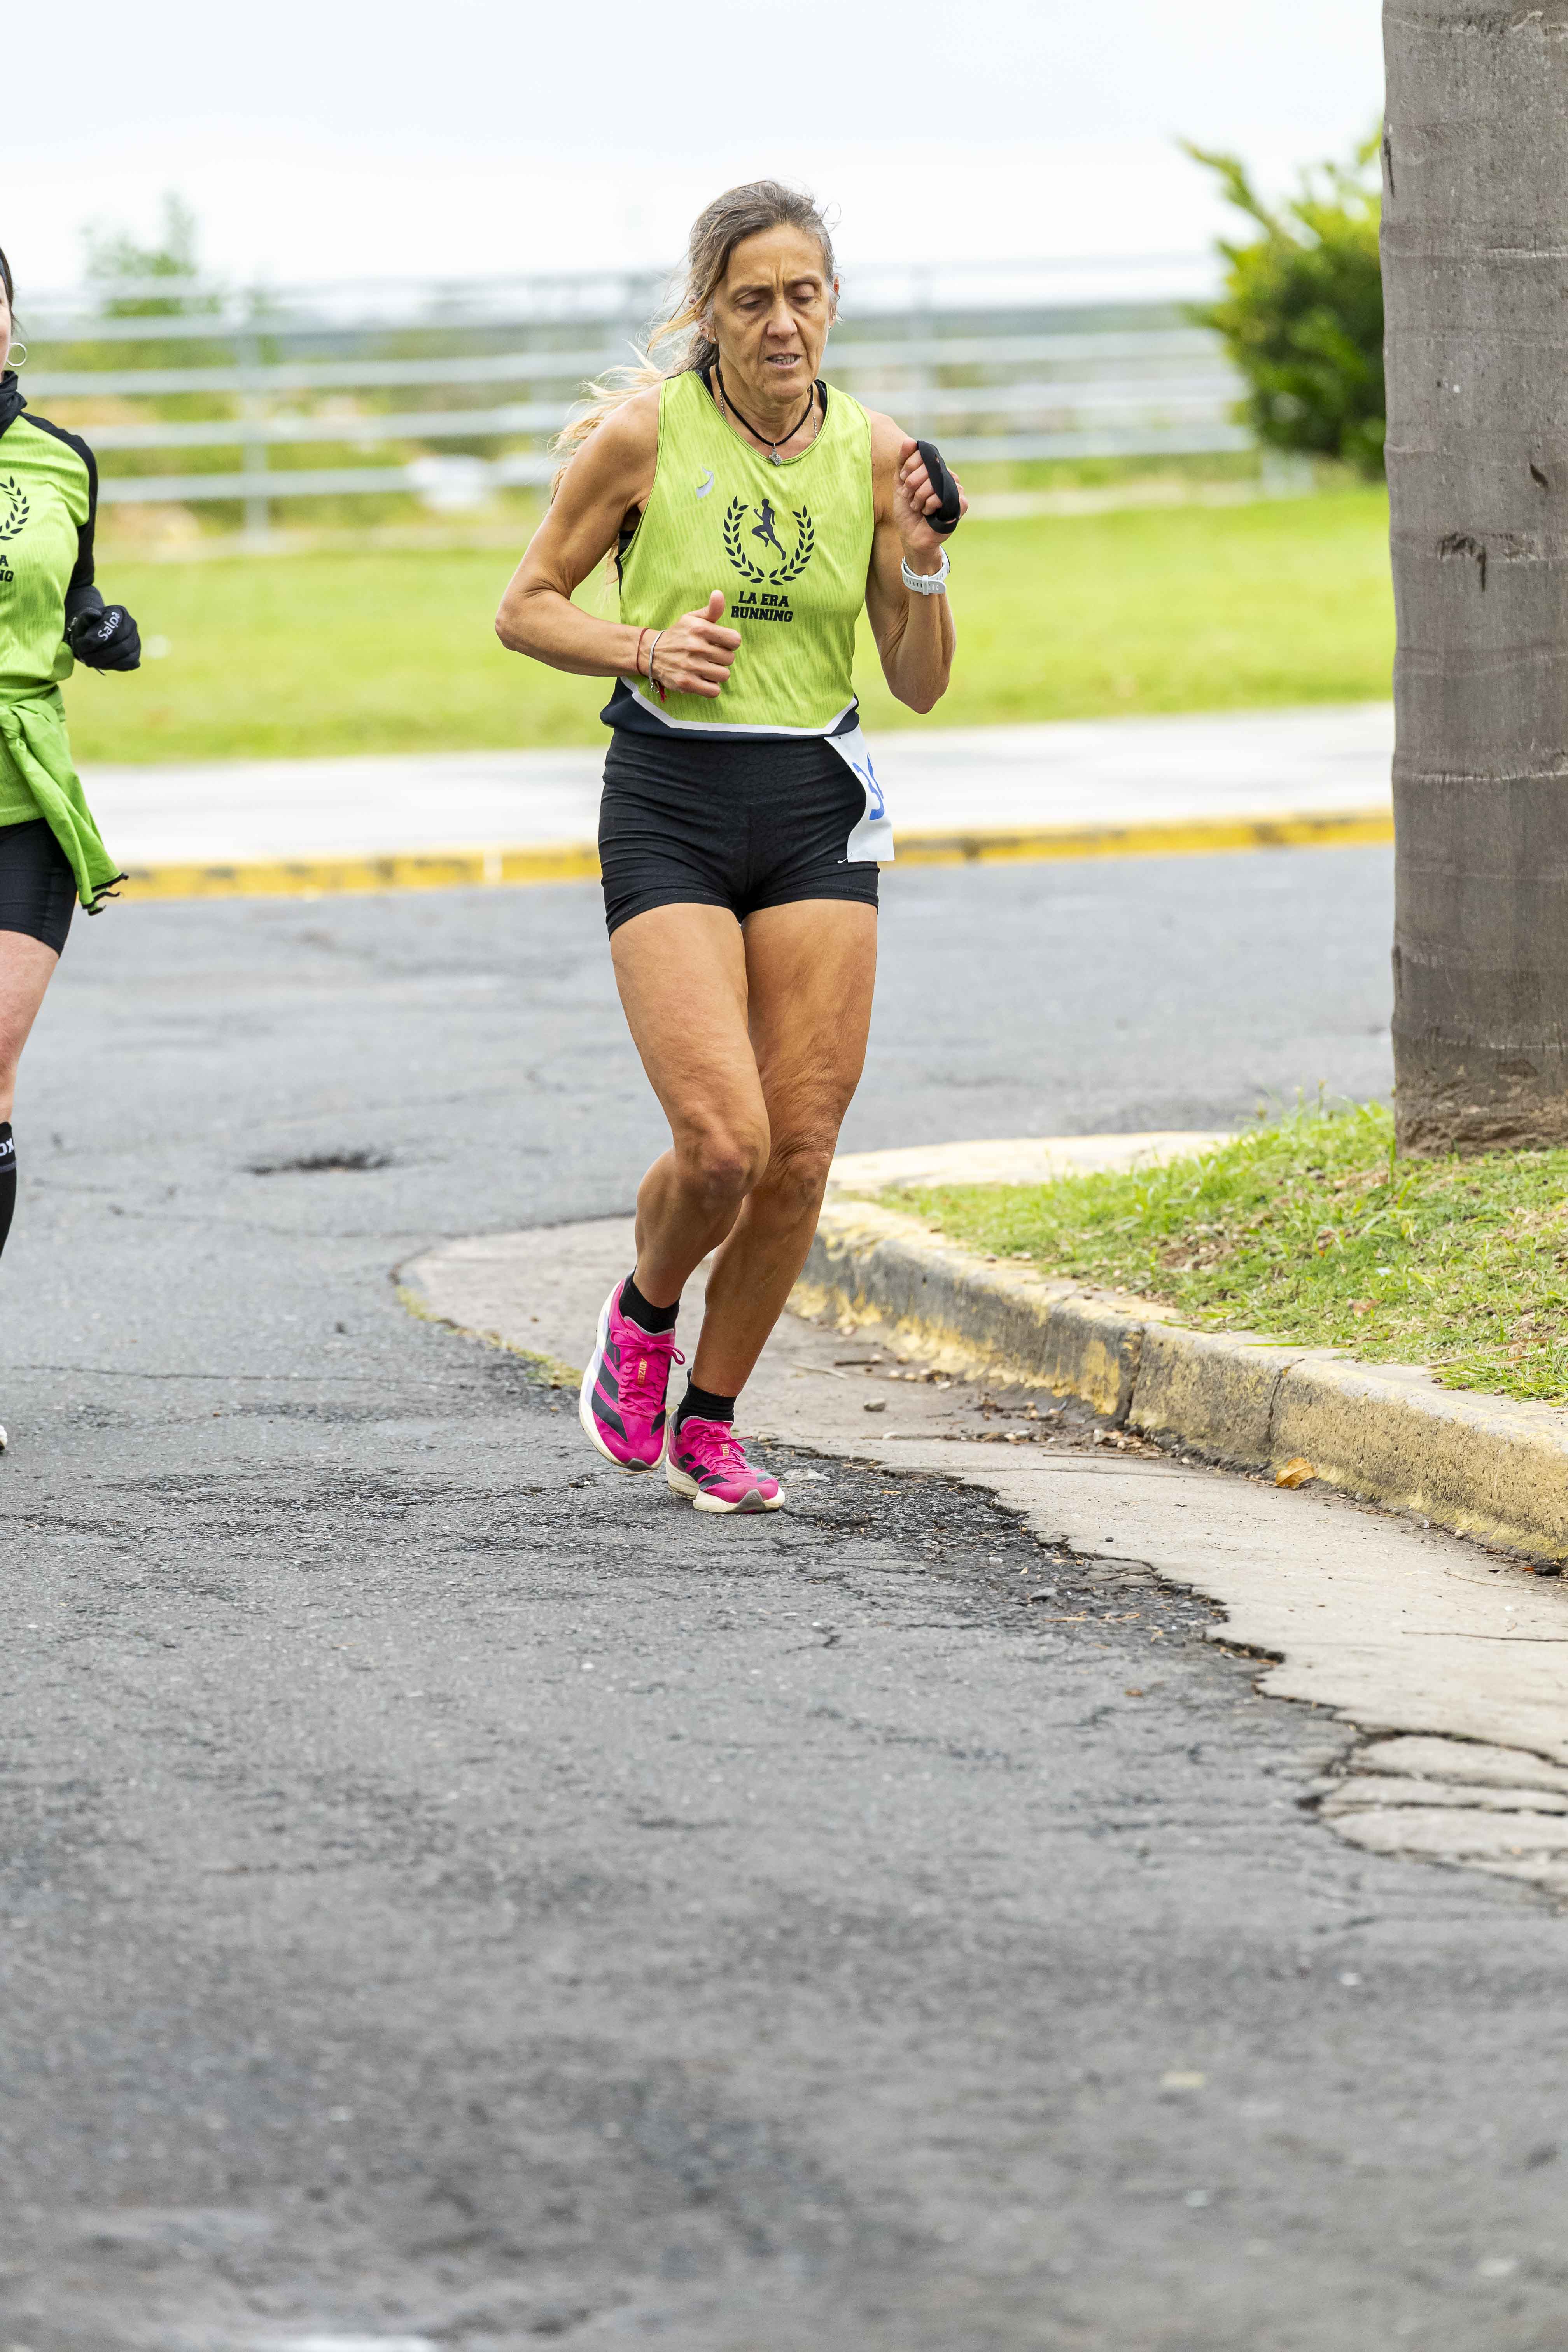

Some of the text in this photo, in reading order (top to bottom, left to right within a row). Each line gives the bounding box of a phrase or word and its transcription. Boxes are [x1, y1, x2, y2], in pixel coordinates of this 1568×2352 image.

[738, 591, 789, 607] LA ERA
[731, 606, 793, 622] RUNNING
[98, 612, 120, 641] Salpa
